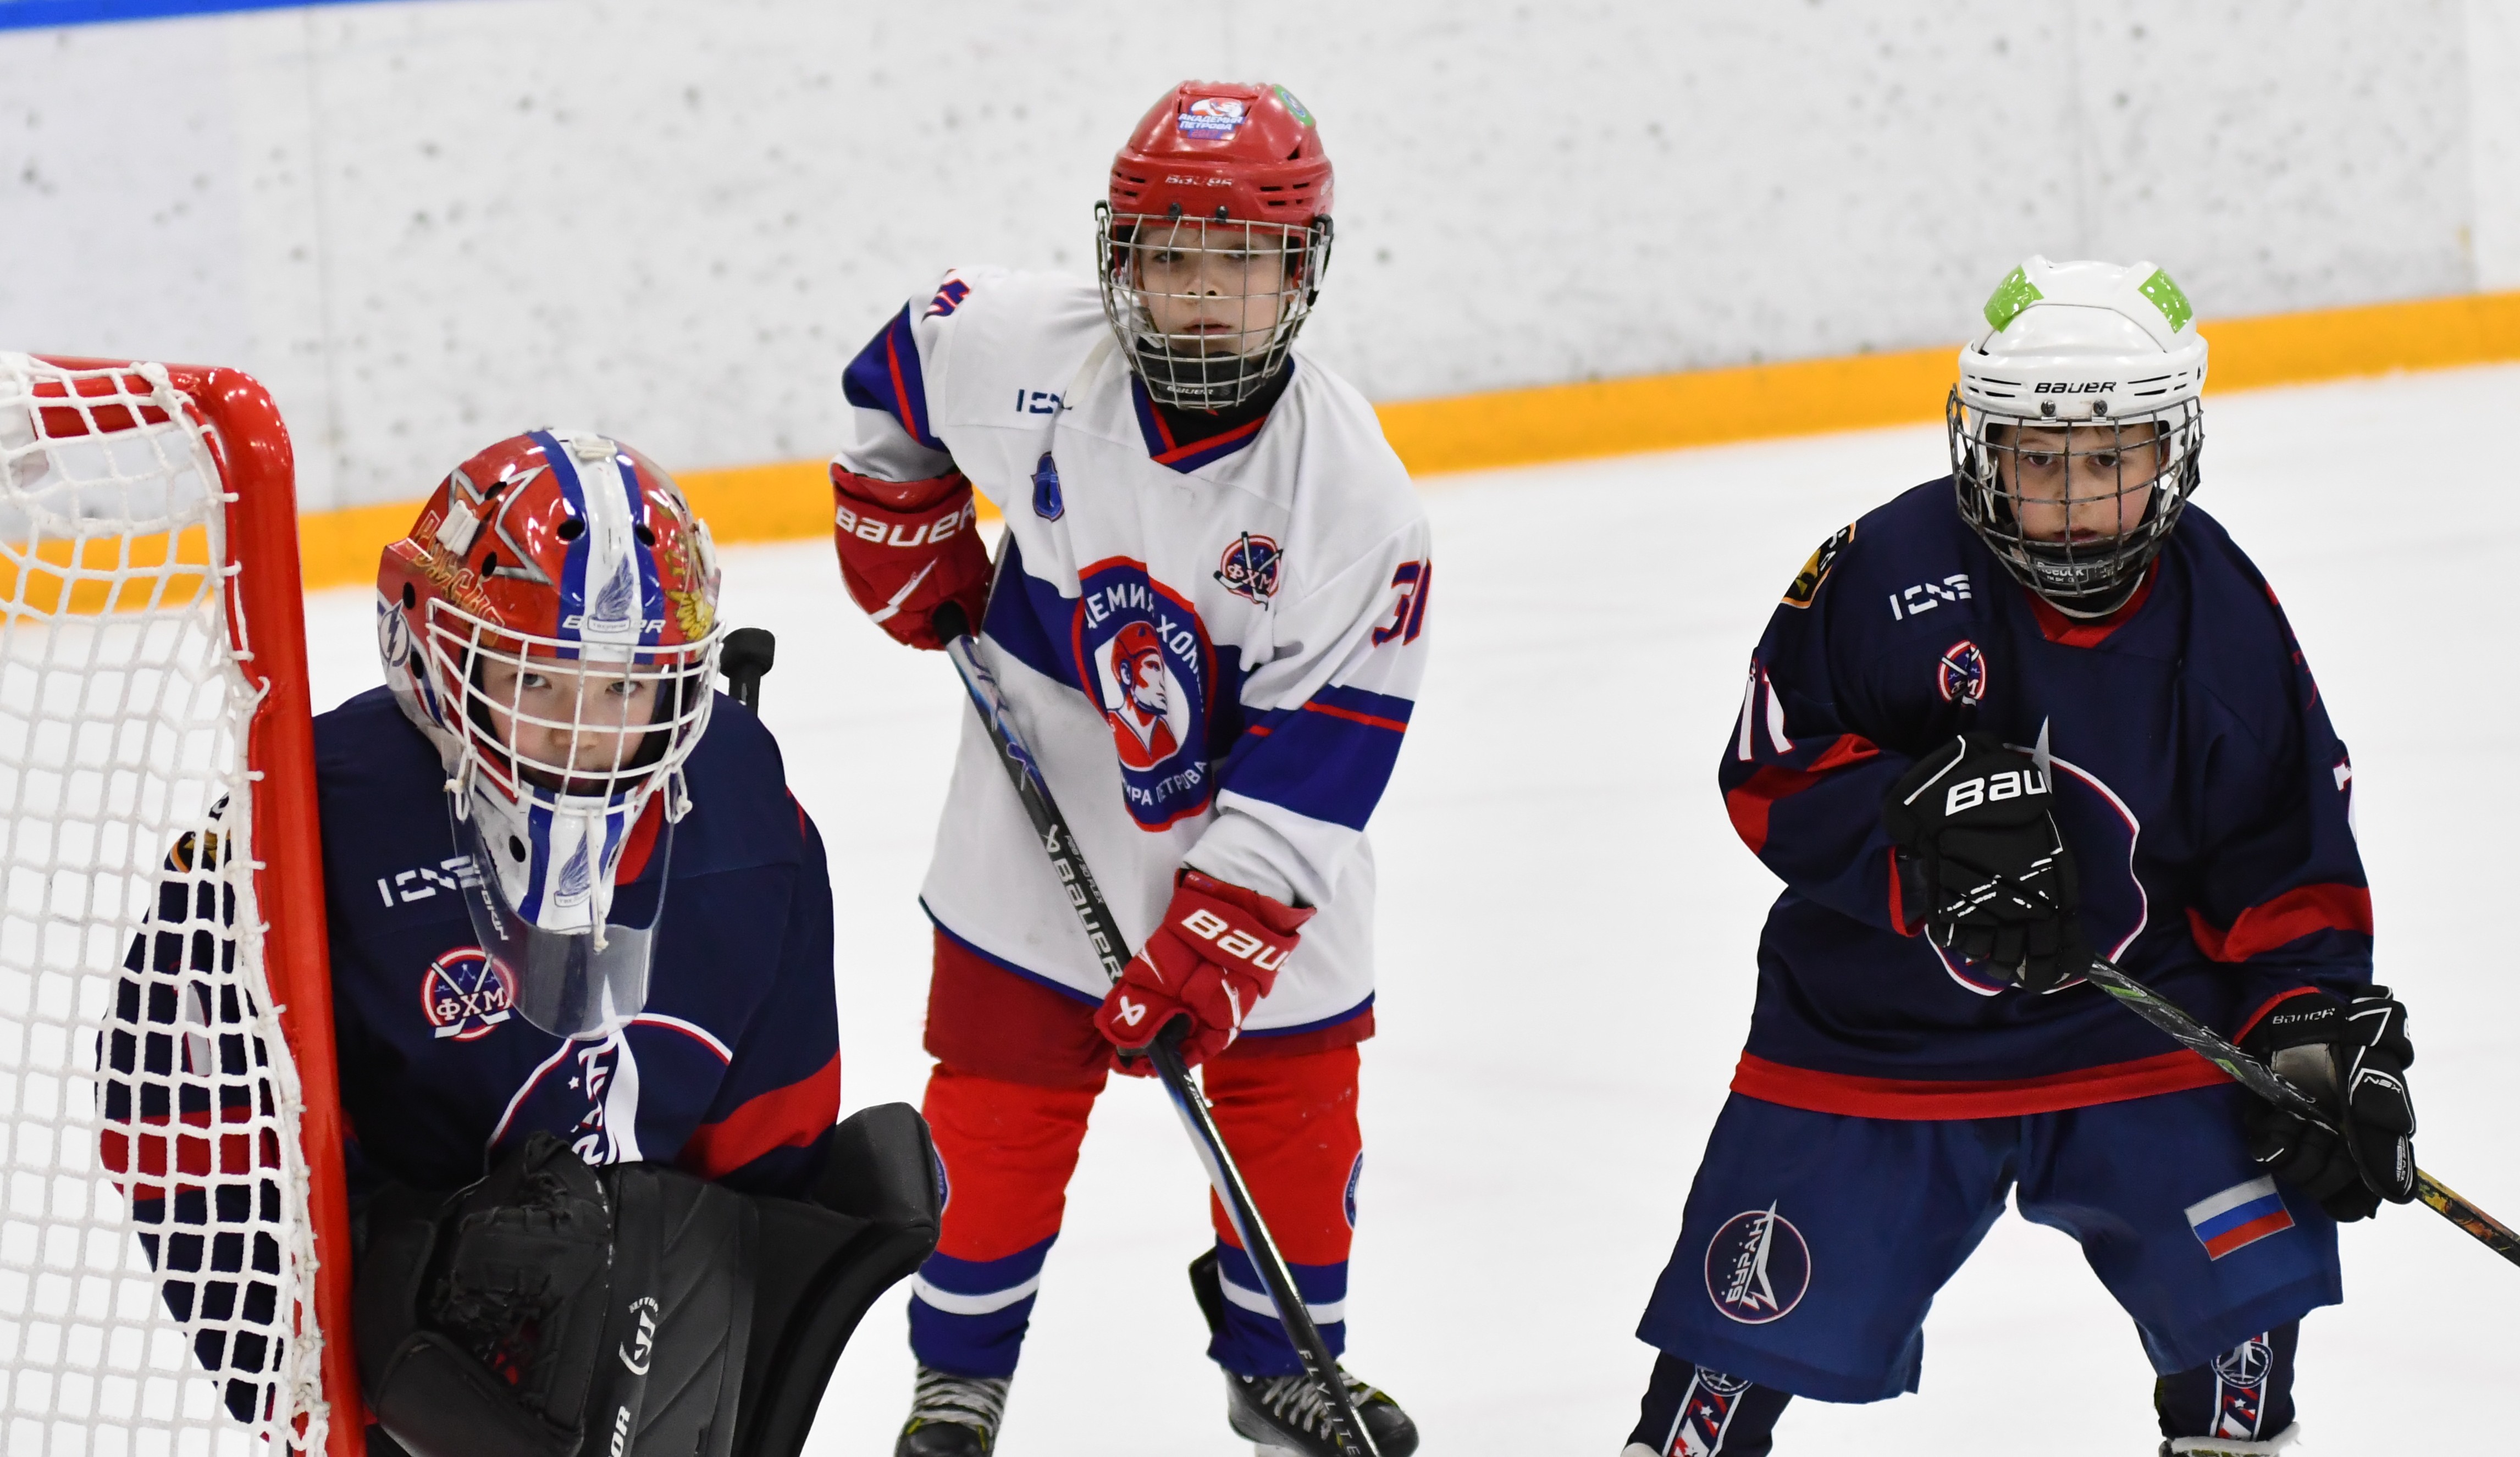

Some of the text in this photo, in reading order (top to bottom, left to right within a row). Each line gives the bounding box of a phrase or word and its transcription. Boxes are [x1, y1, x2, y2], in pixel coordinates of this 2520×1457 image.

[1178, 113, 1244, 124] АКАДЕМИЯ
[1180, 121, 1233, 130] ПЕТРОВА
[1371, 556, 1432, 649] 31
[436, 987, 504, 1021] ФХМ
[1725, 1218, 1769, 1304] БУРАН
[1297, 1349, 1361, 1456] FLYLITE
